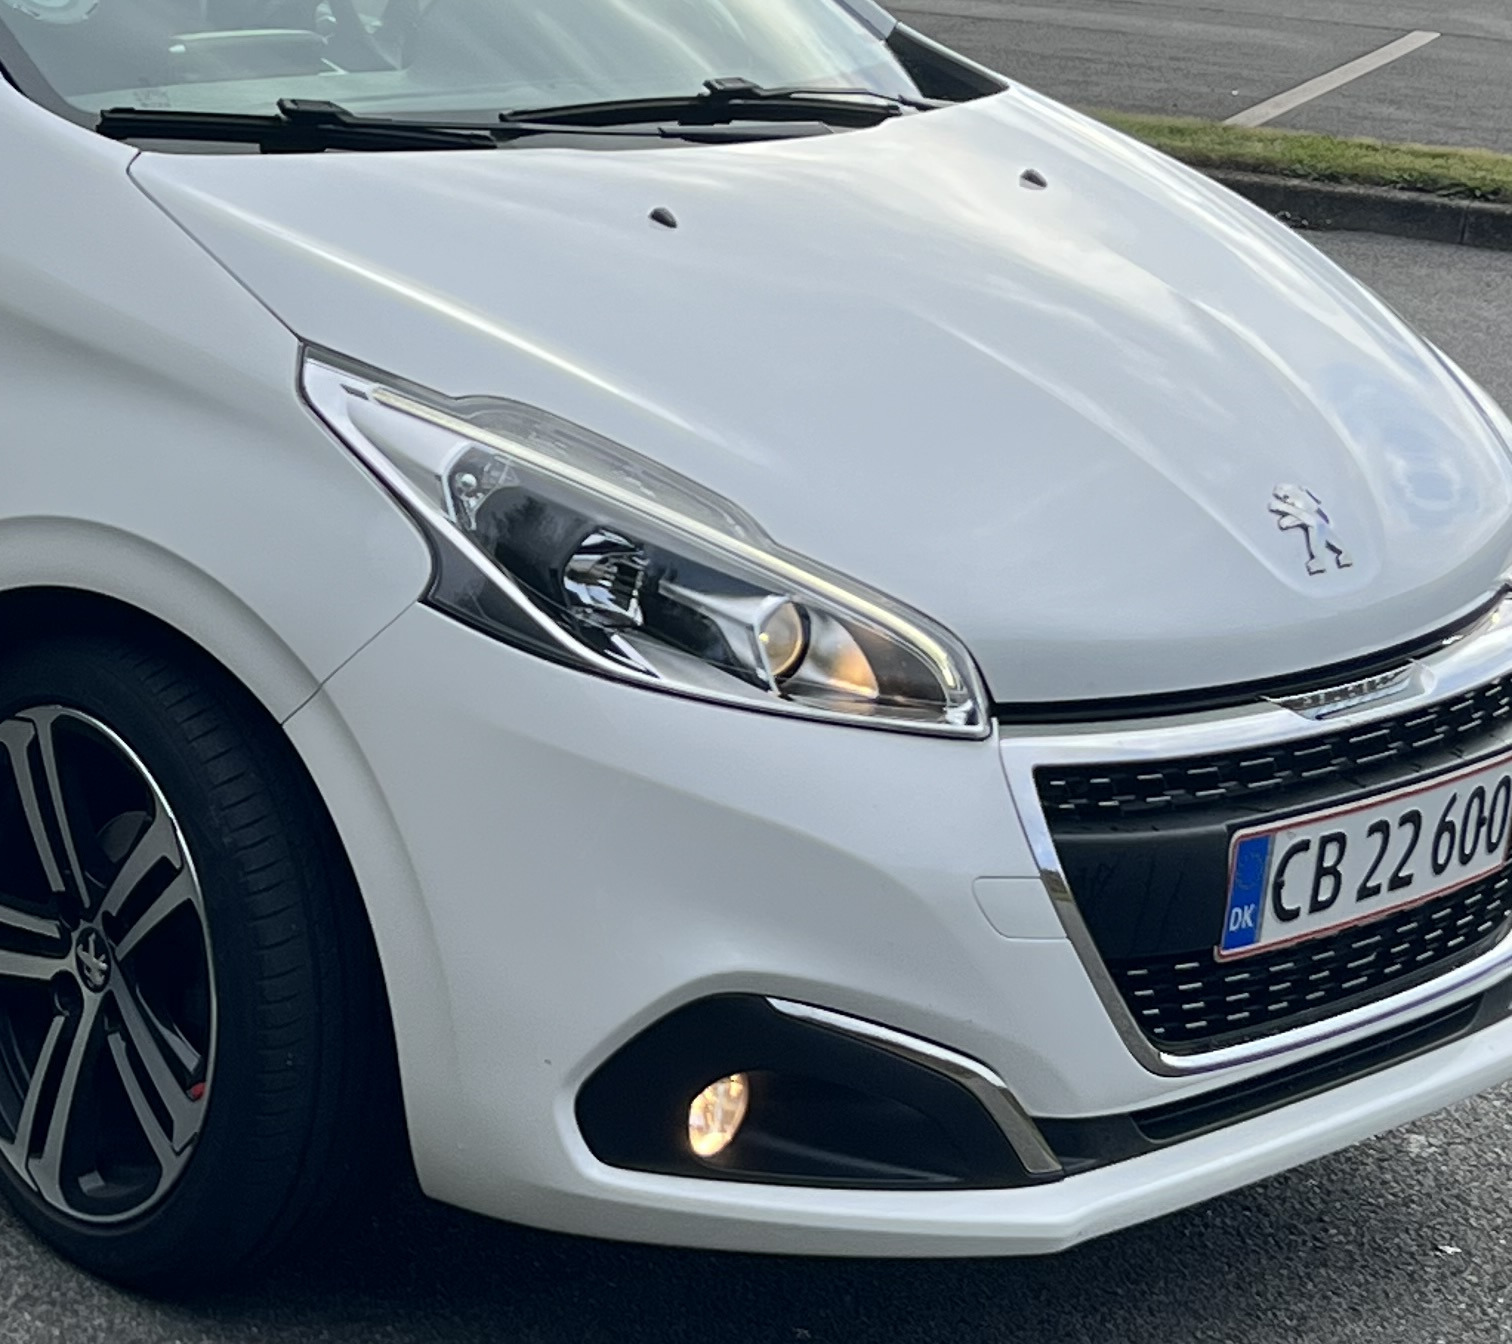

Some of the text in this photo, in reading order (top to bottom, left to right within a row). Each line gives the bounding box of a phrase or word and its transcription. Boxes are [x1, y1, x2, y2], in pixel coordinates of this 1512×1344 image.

[1272, 774, 1511, 923] CB 22 600
[1229, 903, 1256, 932] DK
